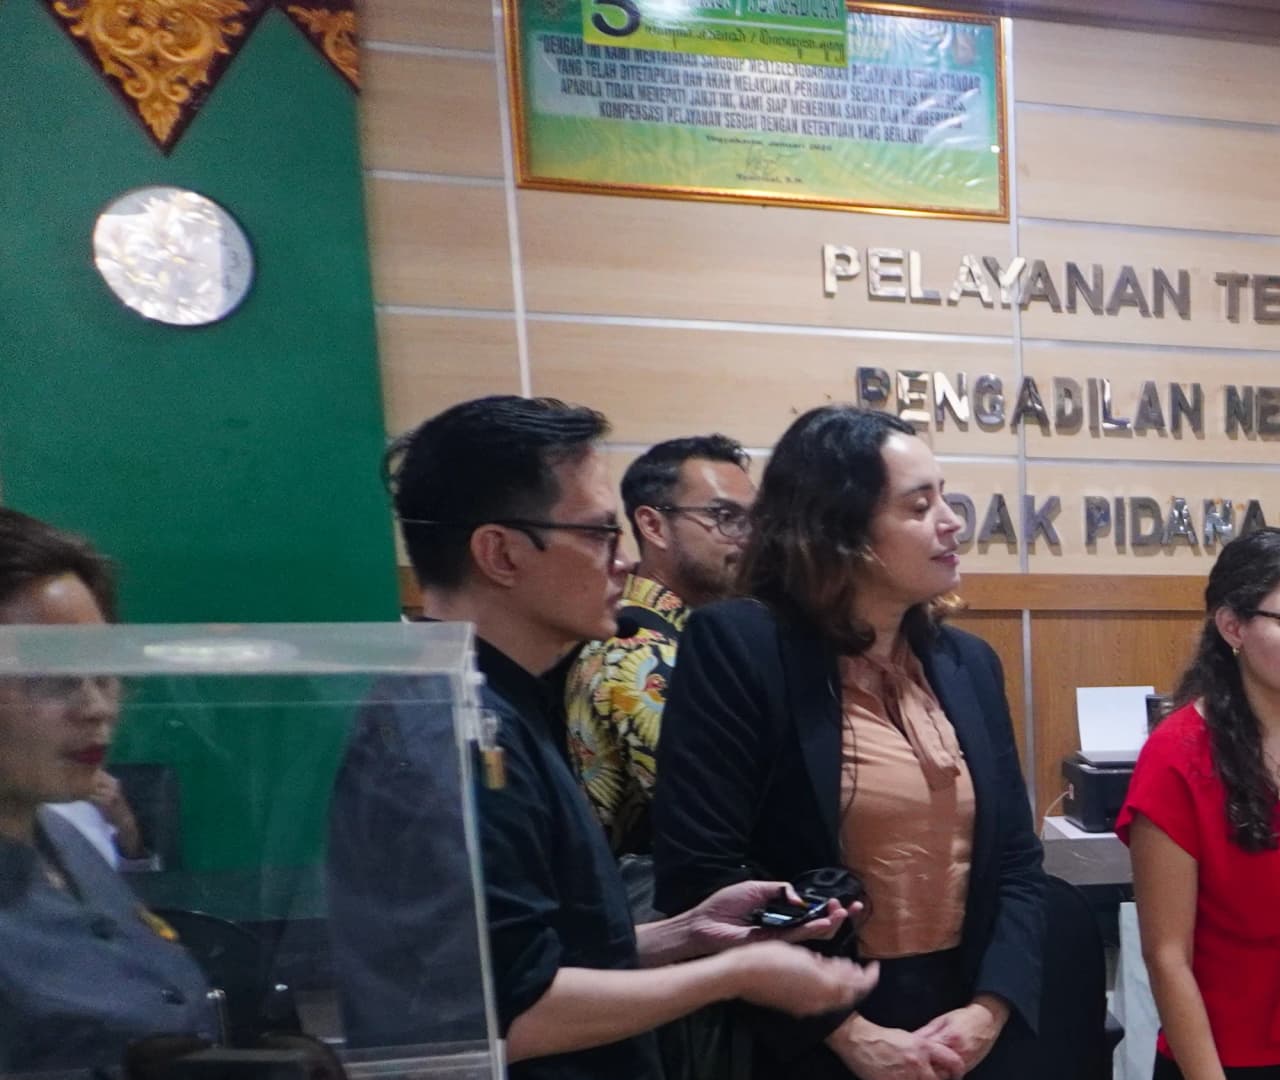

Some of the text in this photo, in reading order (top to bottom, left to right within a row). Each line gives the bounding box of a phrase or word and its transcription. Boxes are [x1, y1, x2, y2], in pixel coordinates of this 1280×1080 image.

[557, 57, 582, 76] YANG
[585, 60, 617, 80] TELAH
[683, 69, 703, 86] DAN
[705, 71, 731, 90] AKAN
[734, 74, 791, 97] MELAKUKAN
[794, 80, 848, 101] PERBAIKAN
[605, 82, 635, 100] TIDAK
[738, 94, 764, 111] KAMI
[766, 96, 788, 114] SIAP
[790, 98, 842, 119] MENERIMA
[667, 106, 722, 127] PELAYANAN
[724, 111, 758, 130] SESUAI
[761, 114, 797, 134] DENGAN
[801, 118, 855, 138] KETENTUAN
[857, 123, 881, 141] YANG
[823, 243, 1192, 320] PELAYANAN
[855, 366, 1205, 440] PENGADILAN
